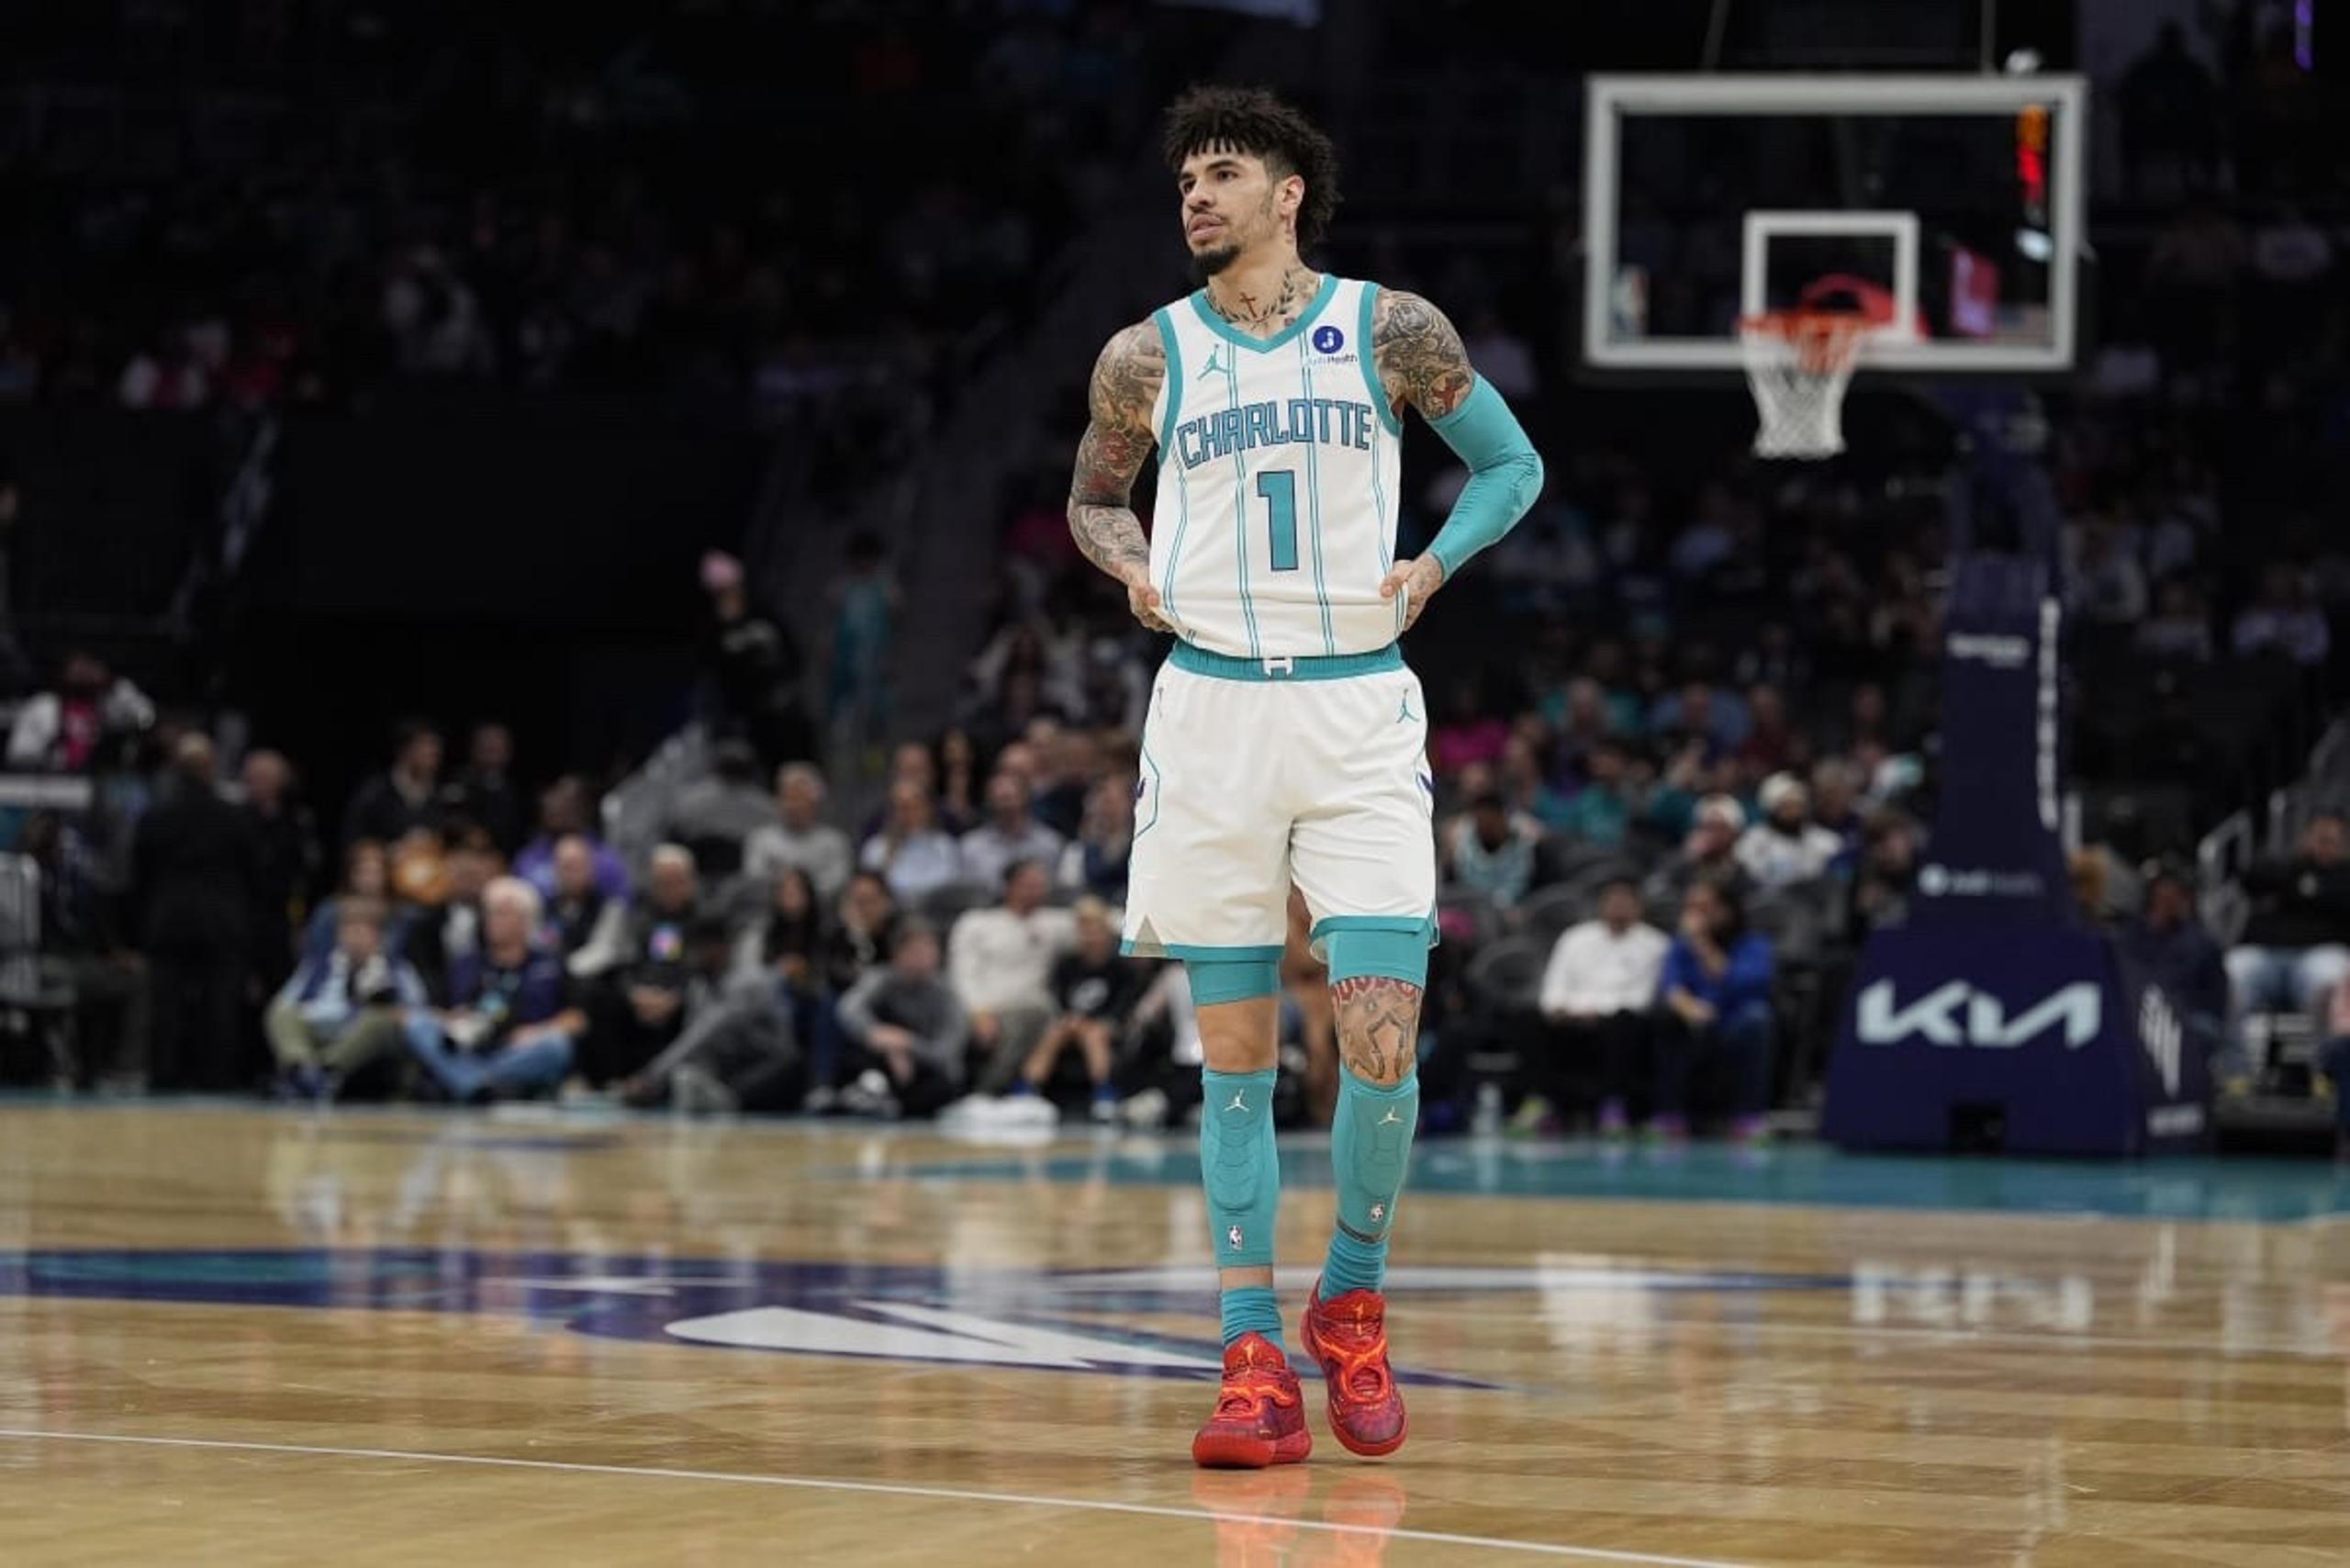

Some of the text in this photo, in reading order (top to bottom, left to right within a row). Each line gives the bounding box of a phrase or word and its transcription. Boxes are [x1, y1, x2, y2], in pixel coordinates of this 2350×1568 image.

[1176, 398, 1372, 470] CHARLOTTE
[1257, 469, 1299, 572] 1
[1857, 978, 2102, 1049] KIA
